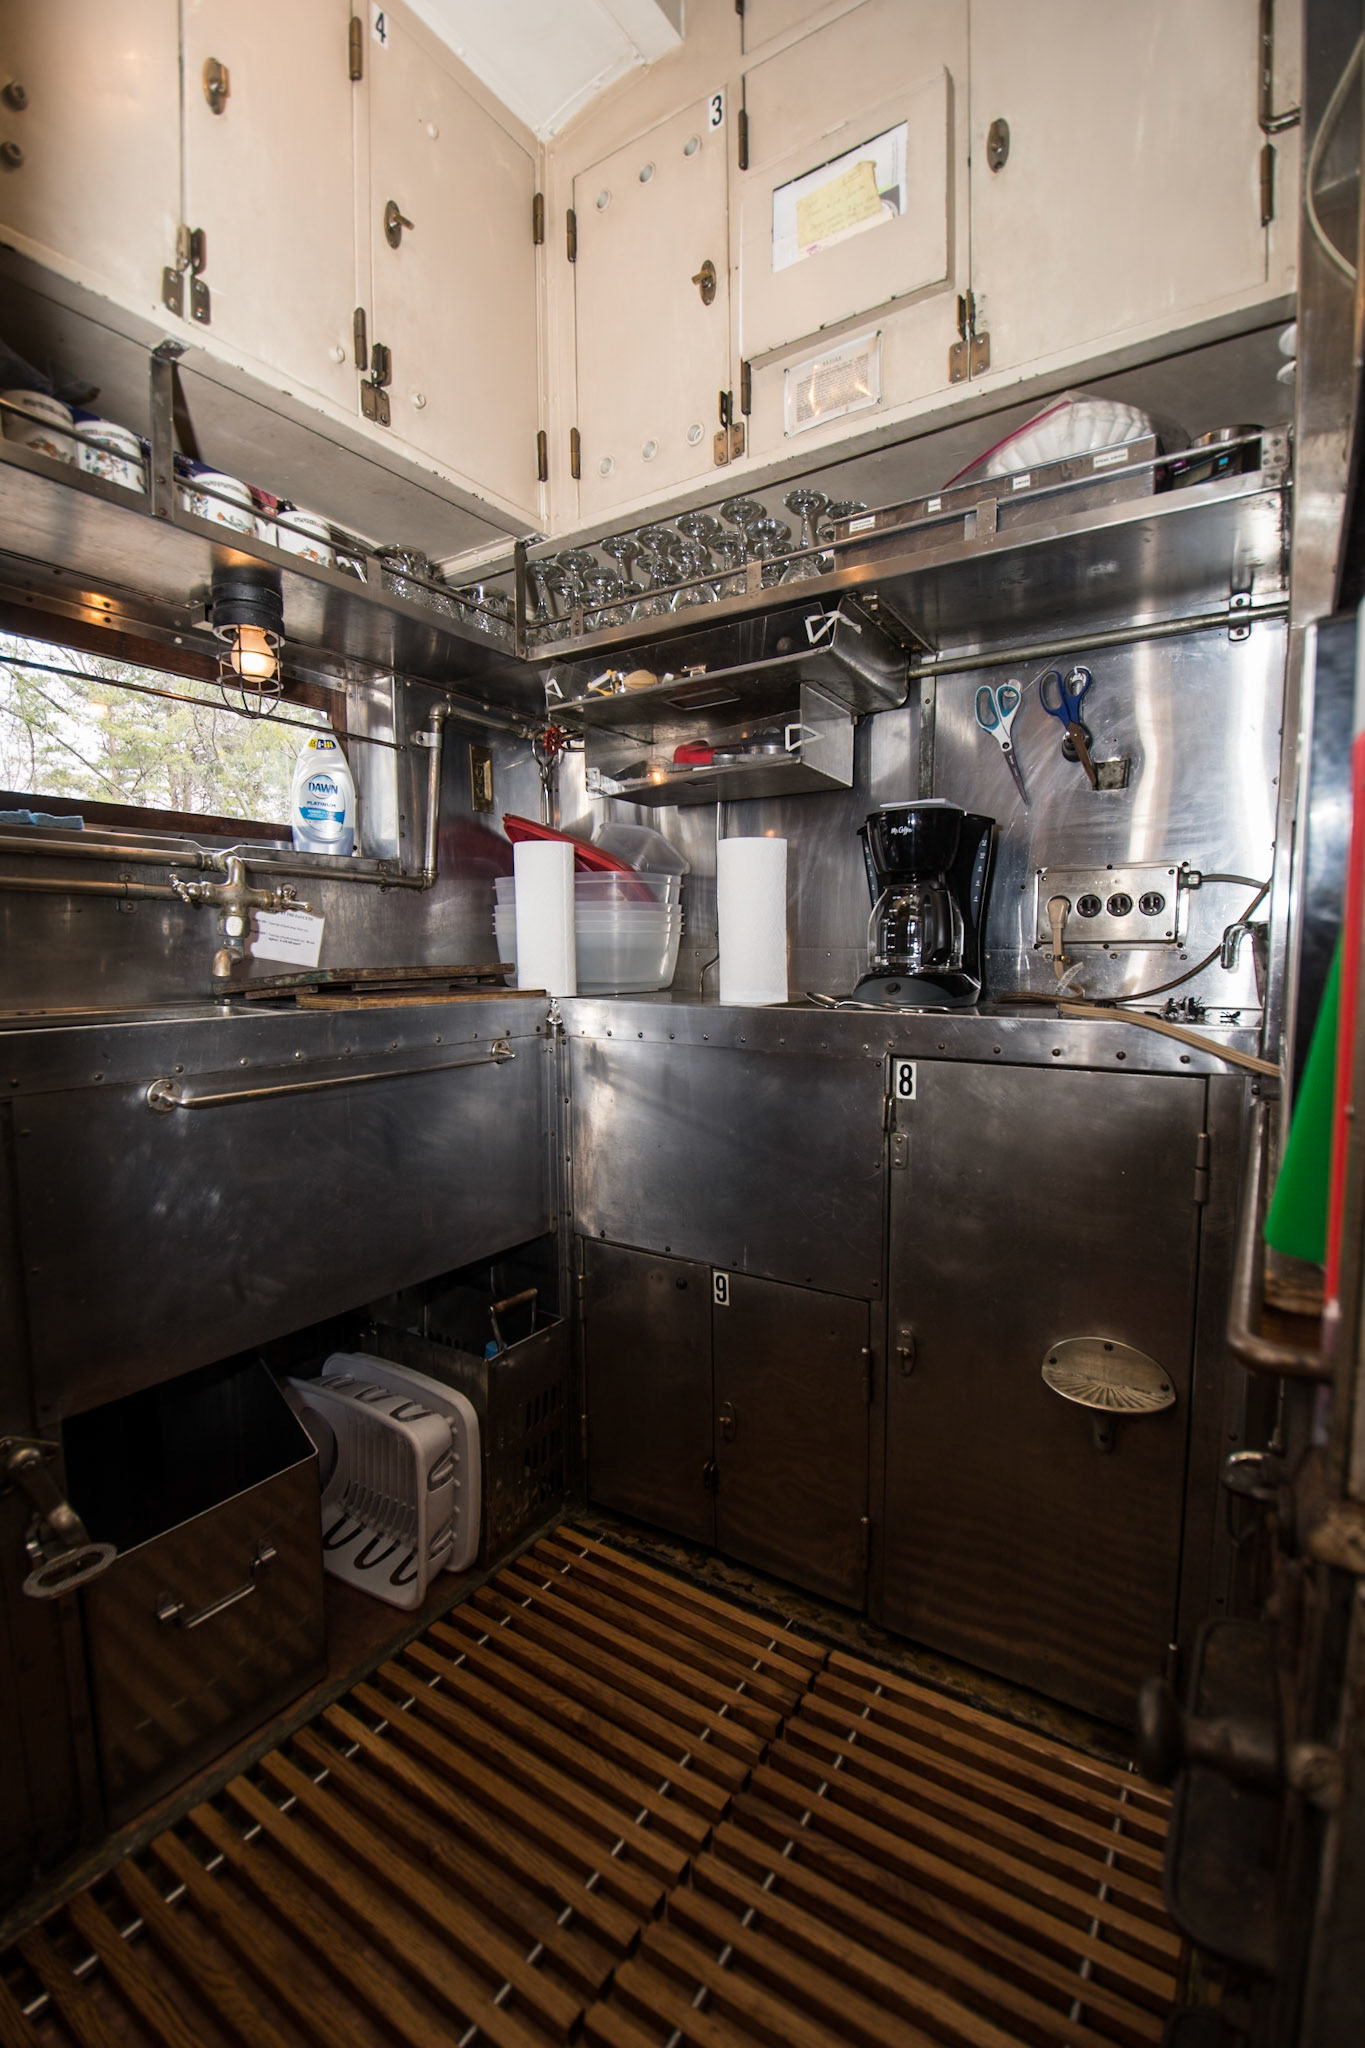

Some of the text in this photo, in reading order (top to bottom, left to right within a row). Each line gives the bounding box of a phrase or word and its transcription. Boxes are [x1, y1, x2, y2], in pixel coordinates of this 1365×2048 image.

[375, 12, 386, 44] 4
[712, 94, 722, 126] 3
[308, 782, 338, 795] DAWN
[899, 1063, 913, 1096] 8
[715, 1275, 727, 1303] 9
